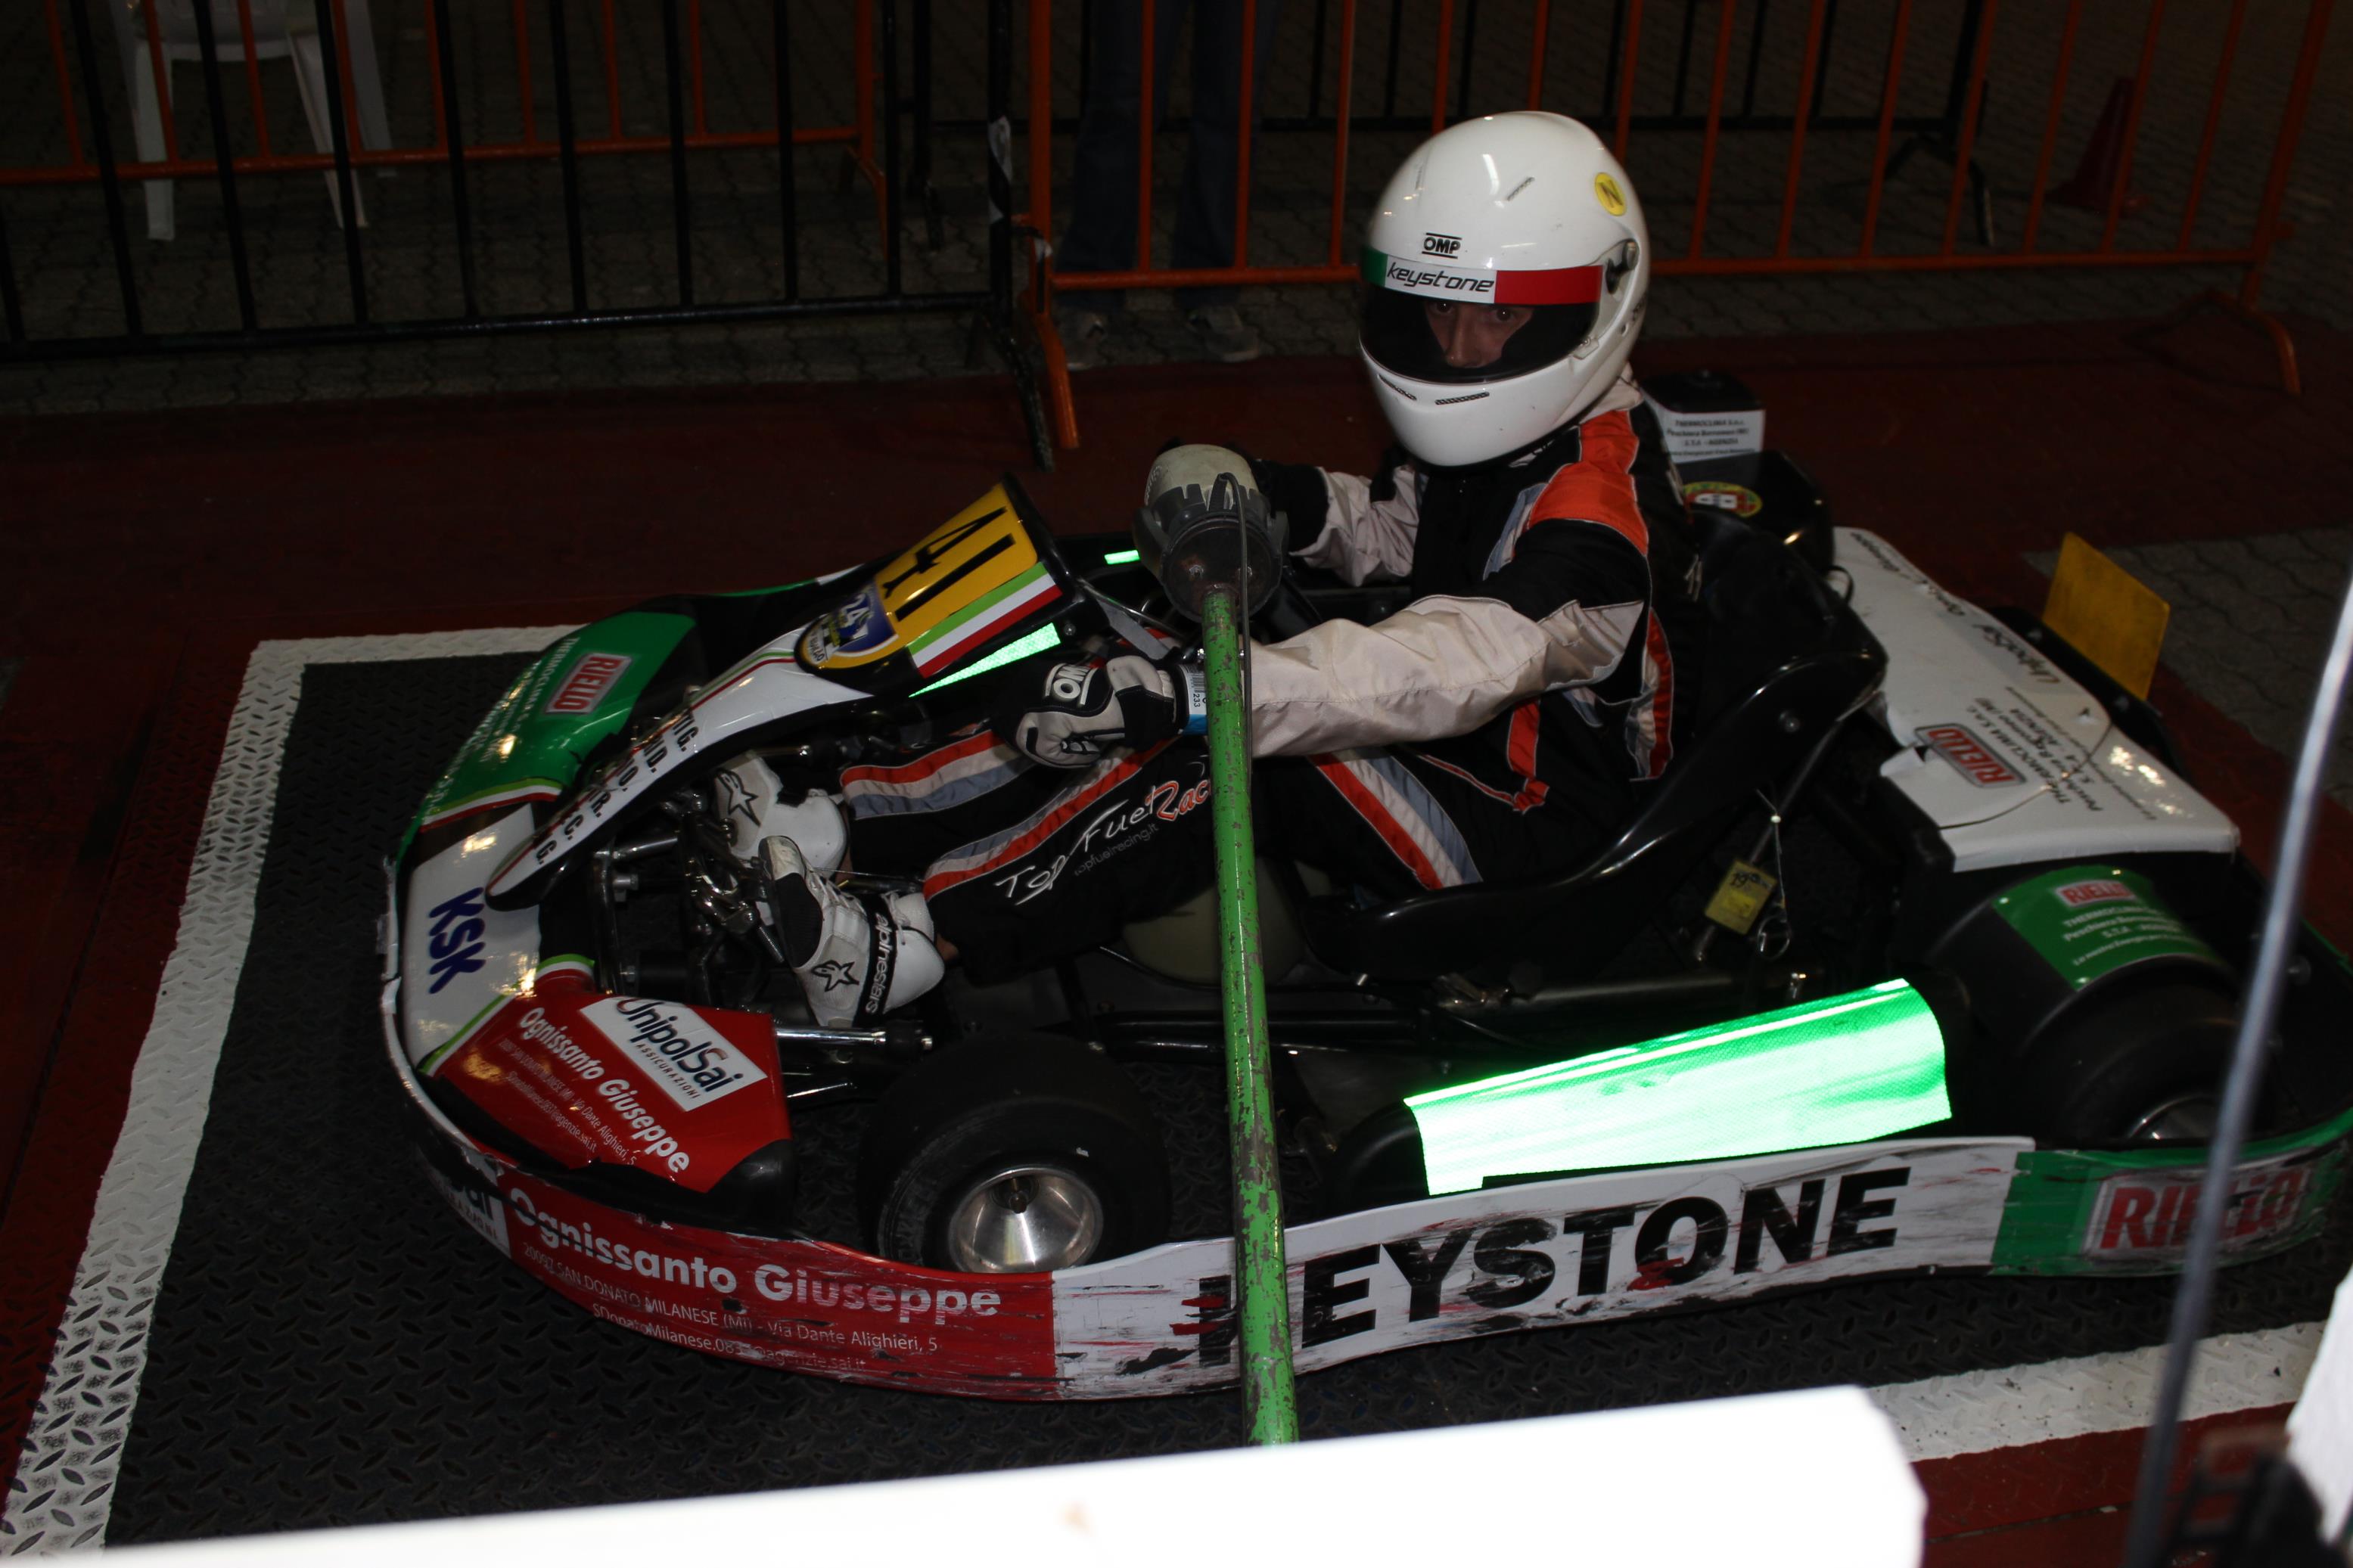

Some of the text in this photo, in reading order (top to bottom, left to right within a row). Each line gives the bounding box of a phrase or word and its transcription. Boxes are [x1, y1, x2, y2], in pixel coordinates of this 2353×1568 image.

[1423, 236, 1461, 255] OMP
[1386, 261, 1495, 293] keystone
[553, 656, 623, 710] RIELLO
[1192, 693, 1201, 708] 233
[1928, 728, 2016, 784] RIELLO
[992, 855, 1068, 906] Top
[1145, 778, 1211, 822] Rac
[1074, 823, 1161, 877] topfuelracing.it
[428, 886, 486, 994] KSK
[865, 911, 894, 1015] alpinestars
[616, 998, 744, 1092] UnipolSai
[636, 1043, 701, 1099] ASSICURAZIONI
[518, 1007, 690, 1173] Ognissanto Giuseppe
[580, 1106, 602, 1128] Dante
[596, 1124, 627, 1162] Alighieri,
[509, 1186, 738, 1294] Ognissanto
[754, 1264, 1002, 1325] Giuseppe
[556, 1261, 582, 1285] SAN
[583, 1275, 642, 1308] DONATO
[645, 1296, 719, 1327] MILANESE
[767, 1321, 793, 1339] Via
[797, 1324, 846, 1345] Dante
[851, 1330, 923, 1353] Alighieri,
[928, 1337, 938, 1352] 5
